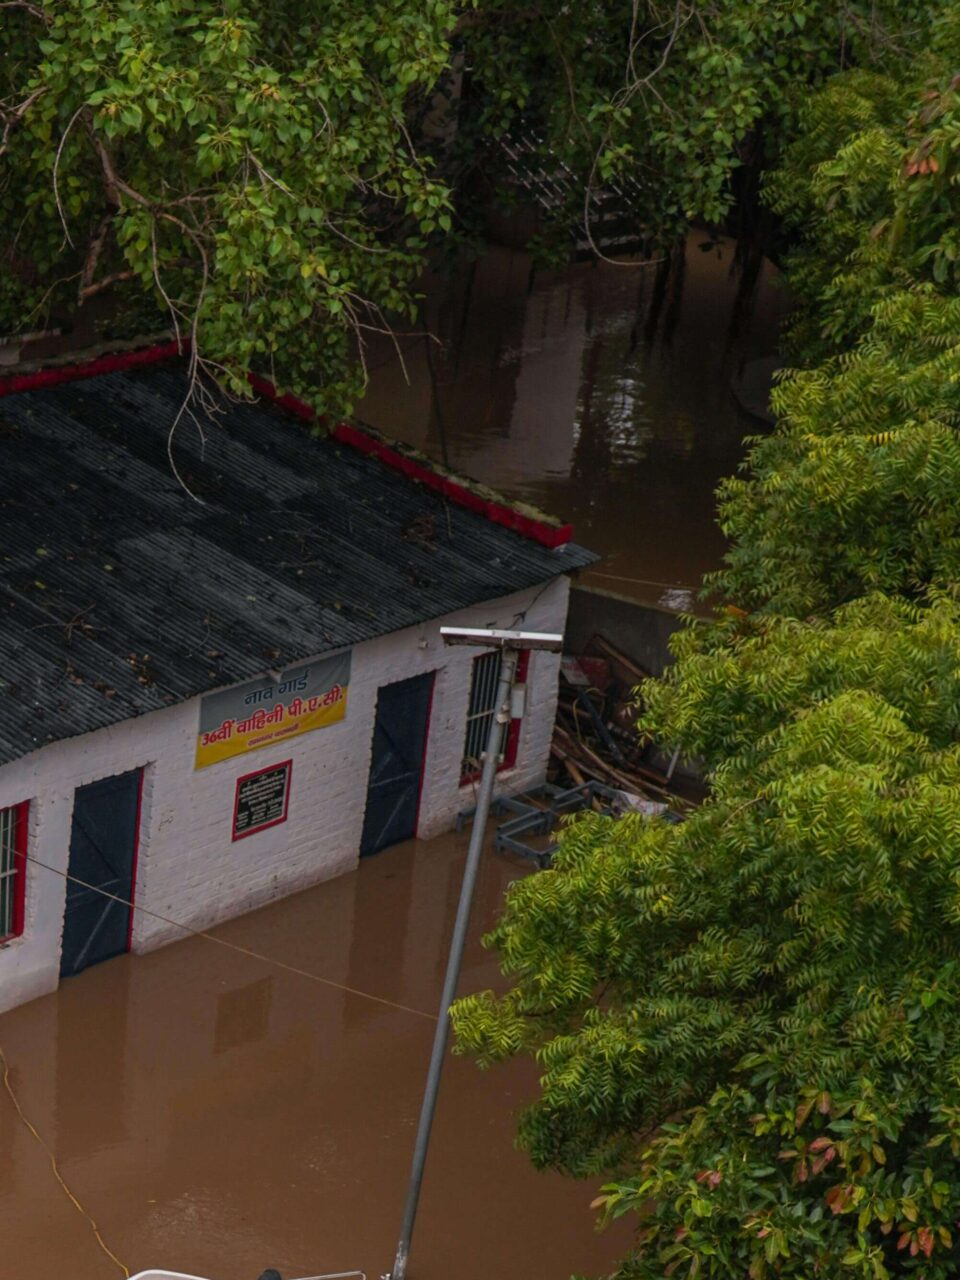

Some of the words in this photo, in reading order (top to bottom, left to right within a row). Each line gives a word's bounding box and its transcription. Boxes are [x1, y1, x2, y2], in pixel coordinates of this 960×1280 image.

[244, 687, 273, 705] नाव
[278, 670, 309, 694] गार्ड
[202, 719, 235, 746] 36वीं
[236, 704, 283, 733] वाहिनी
[288, 684, 343, 717] पी.ए.सी.
